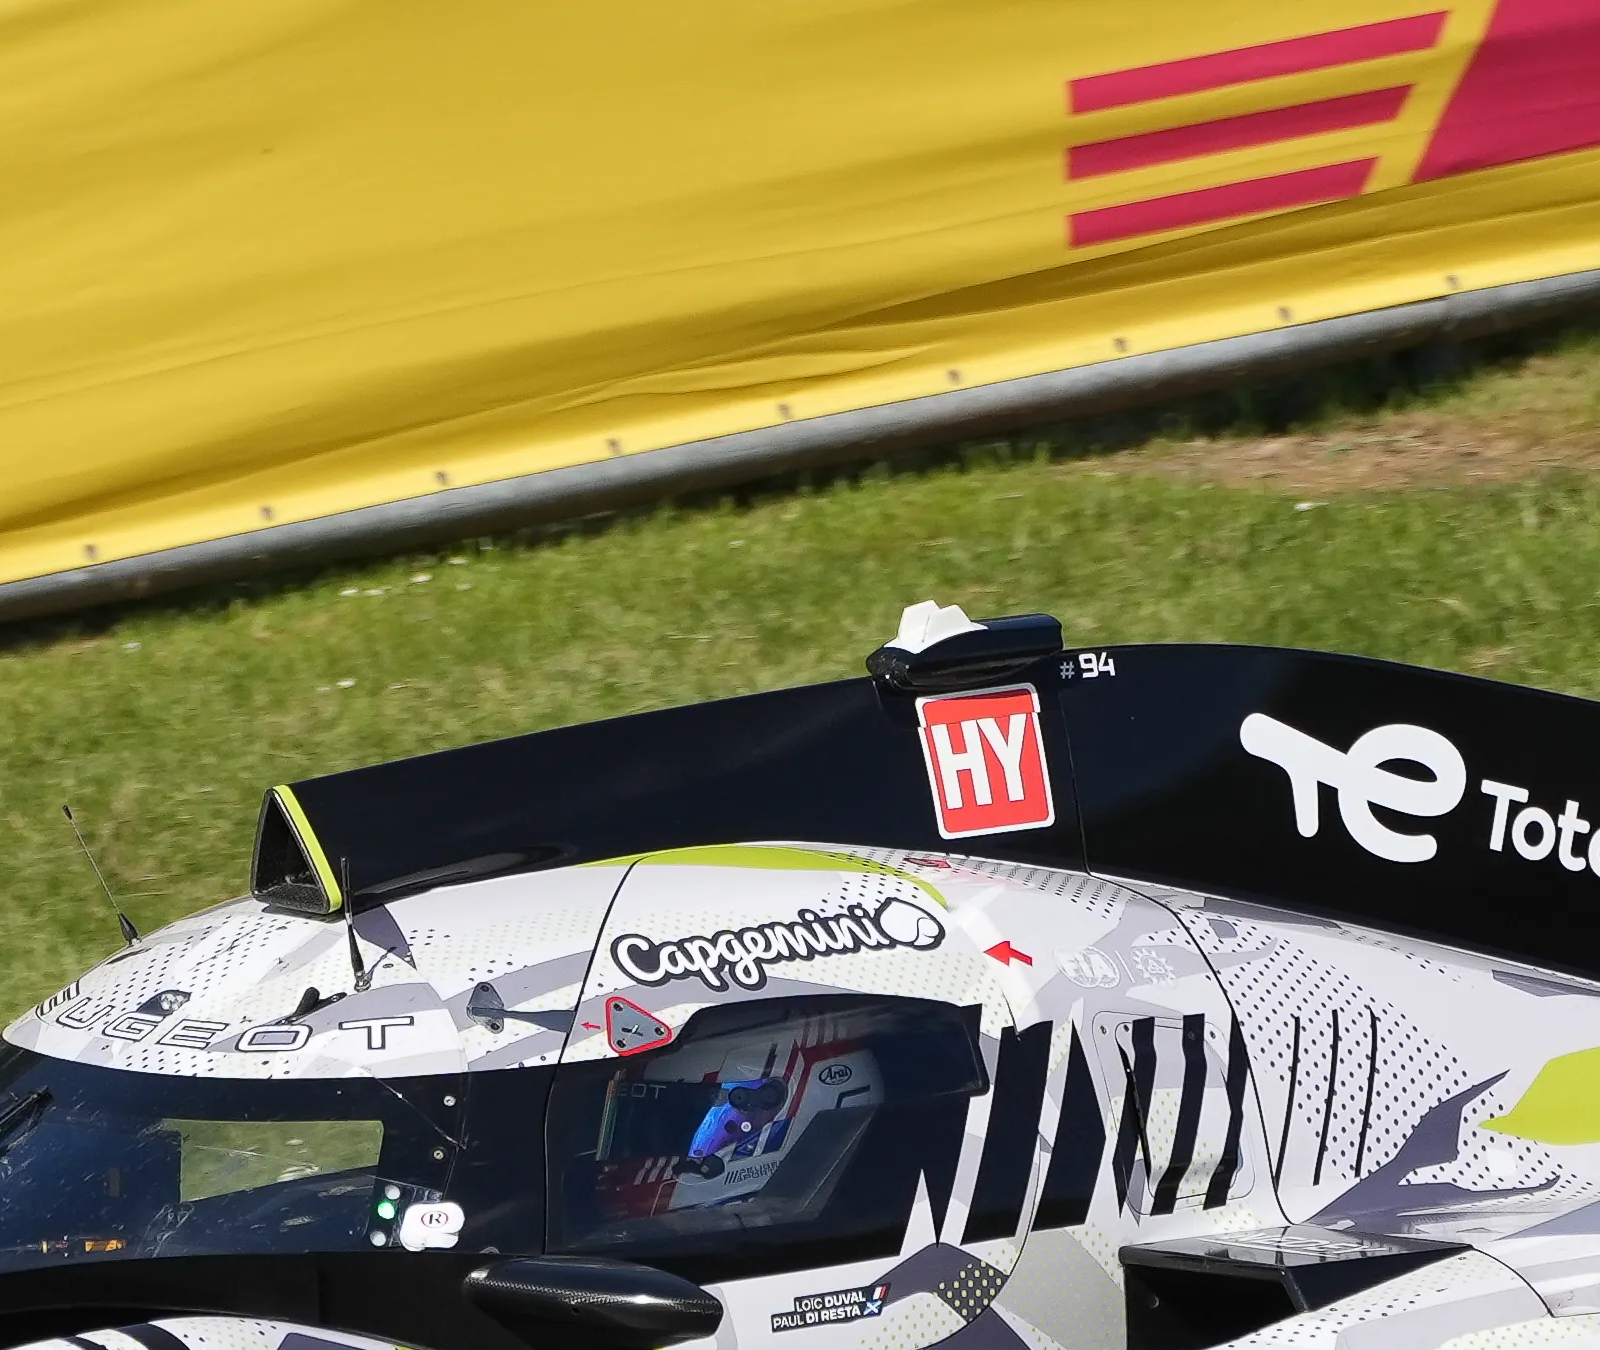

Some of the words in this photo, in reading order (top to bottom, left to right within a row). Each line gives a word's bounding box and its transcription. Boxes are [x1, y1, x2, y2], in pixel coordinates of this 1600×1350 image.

[930, 712, 1027, 810] HY
[613, 906, 890, 988] Capgemini
[772, 1314, 805, 1330] PAUL
[805, 1311, 820, 1325] DI
[821, 1305, 862, 1322] RESTA
[824, 1291, 867, 1308] DUVAL
